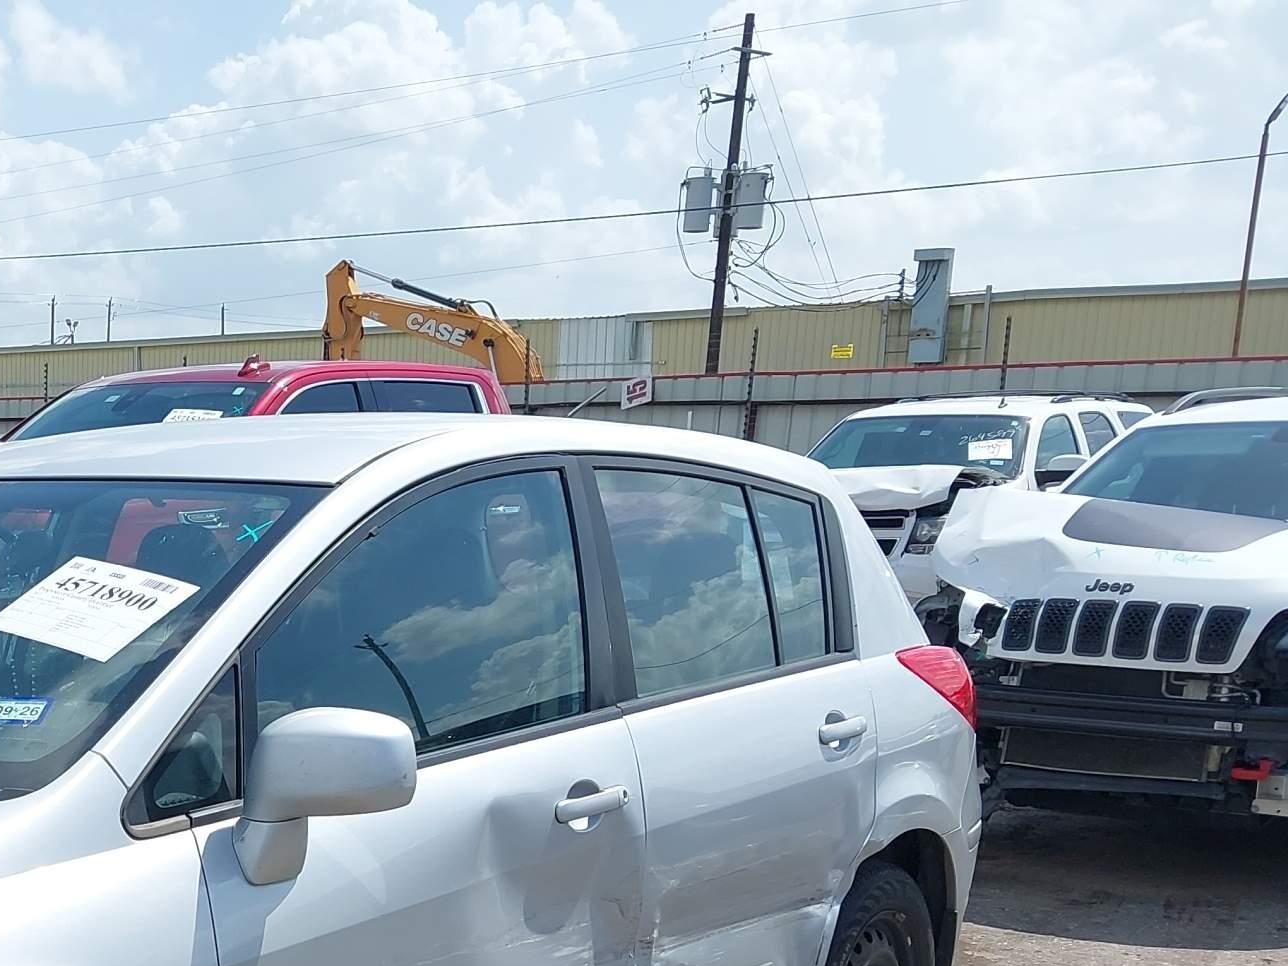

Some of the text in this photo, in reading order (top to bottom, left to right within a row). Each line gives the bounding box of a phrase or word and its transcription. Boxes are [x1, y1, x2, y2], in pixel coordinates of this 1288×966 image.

[406, 312, 468, 347] CASE
[626, 379, 648, 406] 15
[55, 576, 159, 612] 45718900
[1085, 578, 1135, 595] Jeep
